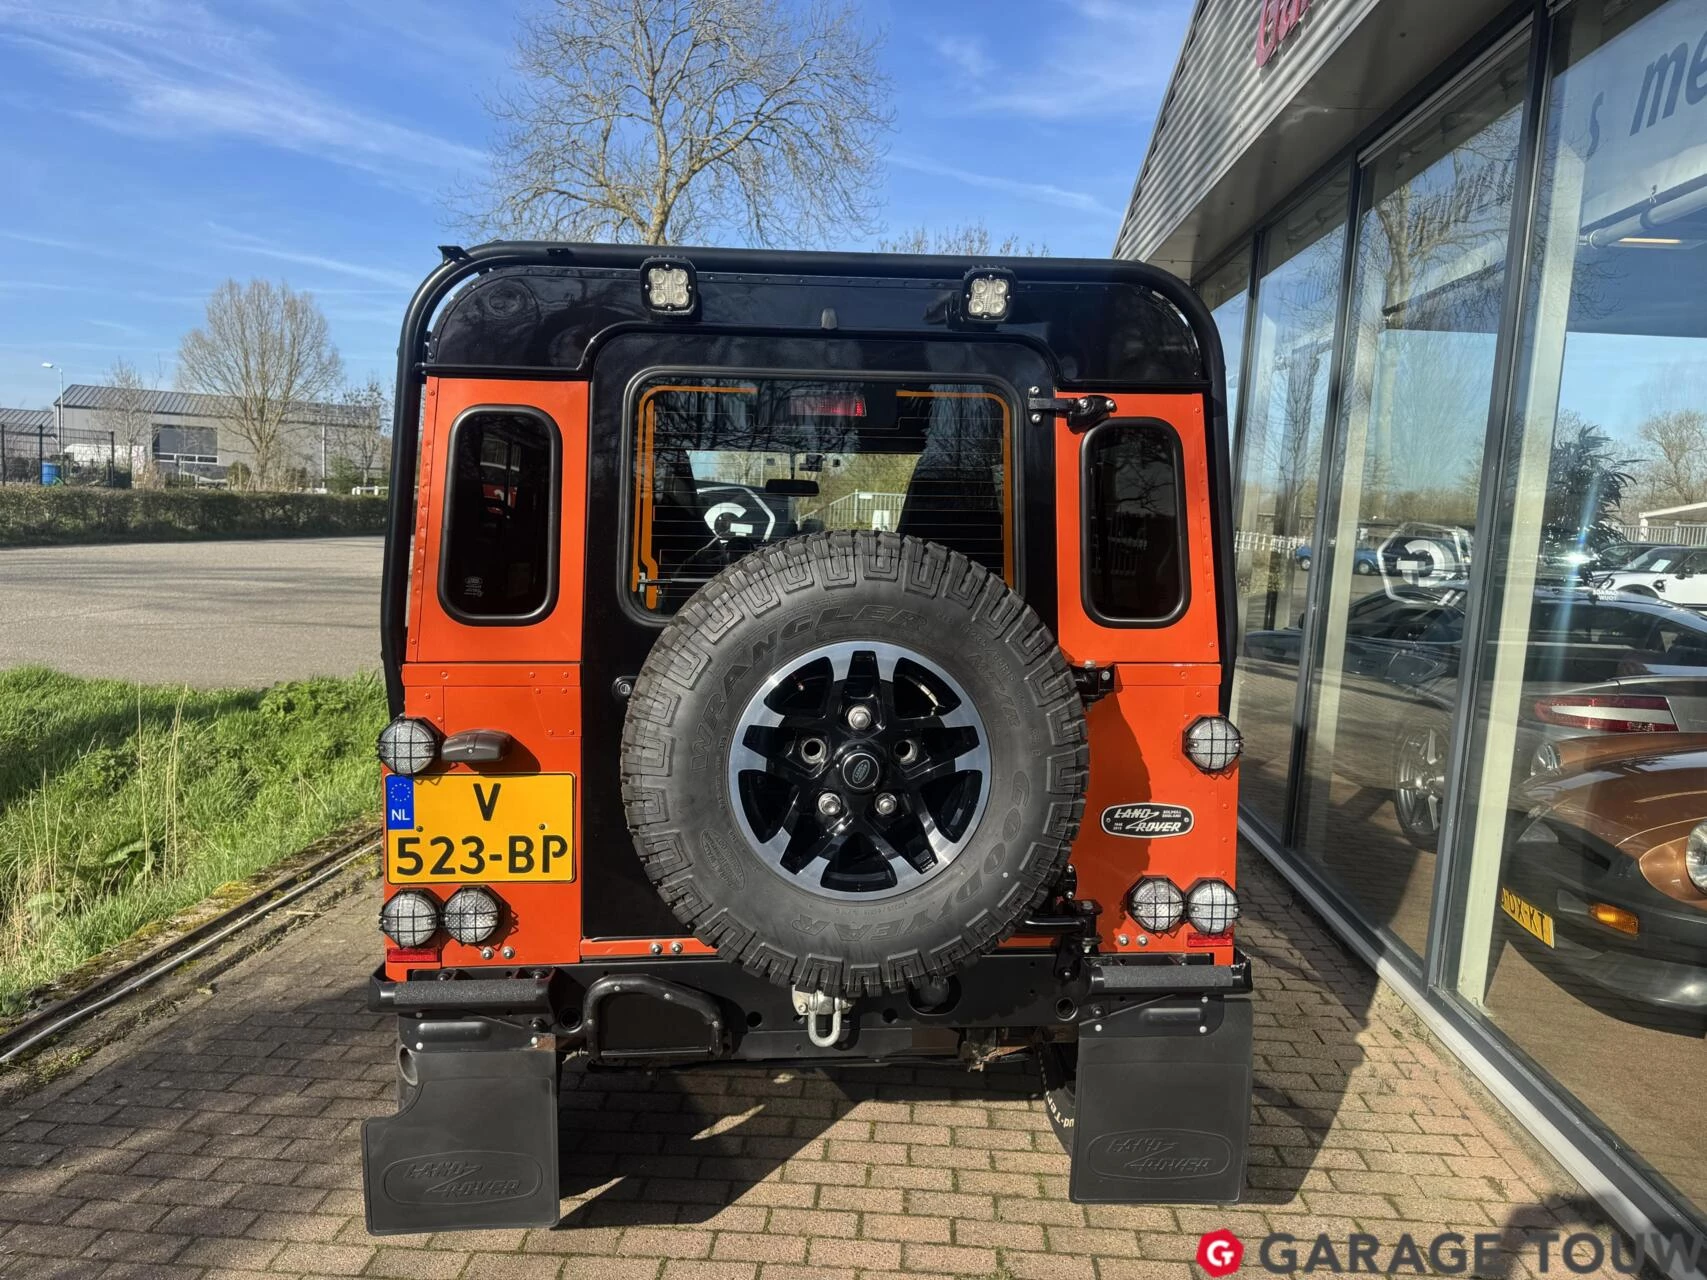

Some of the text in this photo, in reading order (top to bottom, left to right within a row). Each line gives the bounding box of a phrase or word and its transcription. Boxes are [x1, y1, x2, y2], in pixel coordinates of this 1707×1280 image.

[692, 604, 928, 772] WRANGLER
[473, 783, 502, 821] V
[391, 808, 411, 821] NL
[1114, 808, 1152, 819] LAND
[1135, 821, 1182, 832] ROVER
[396, 835, 568, 876] 523-BP
[406, 1159, 468, 1179] LAND
[446, 1178, 522, 1198] ROVER
